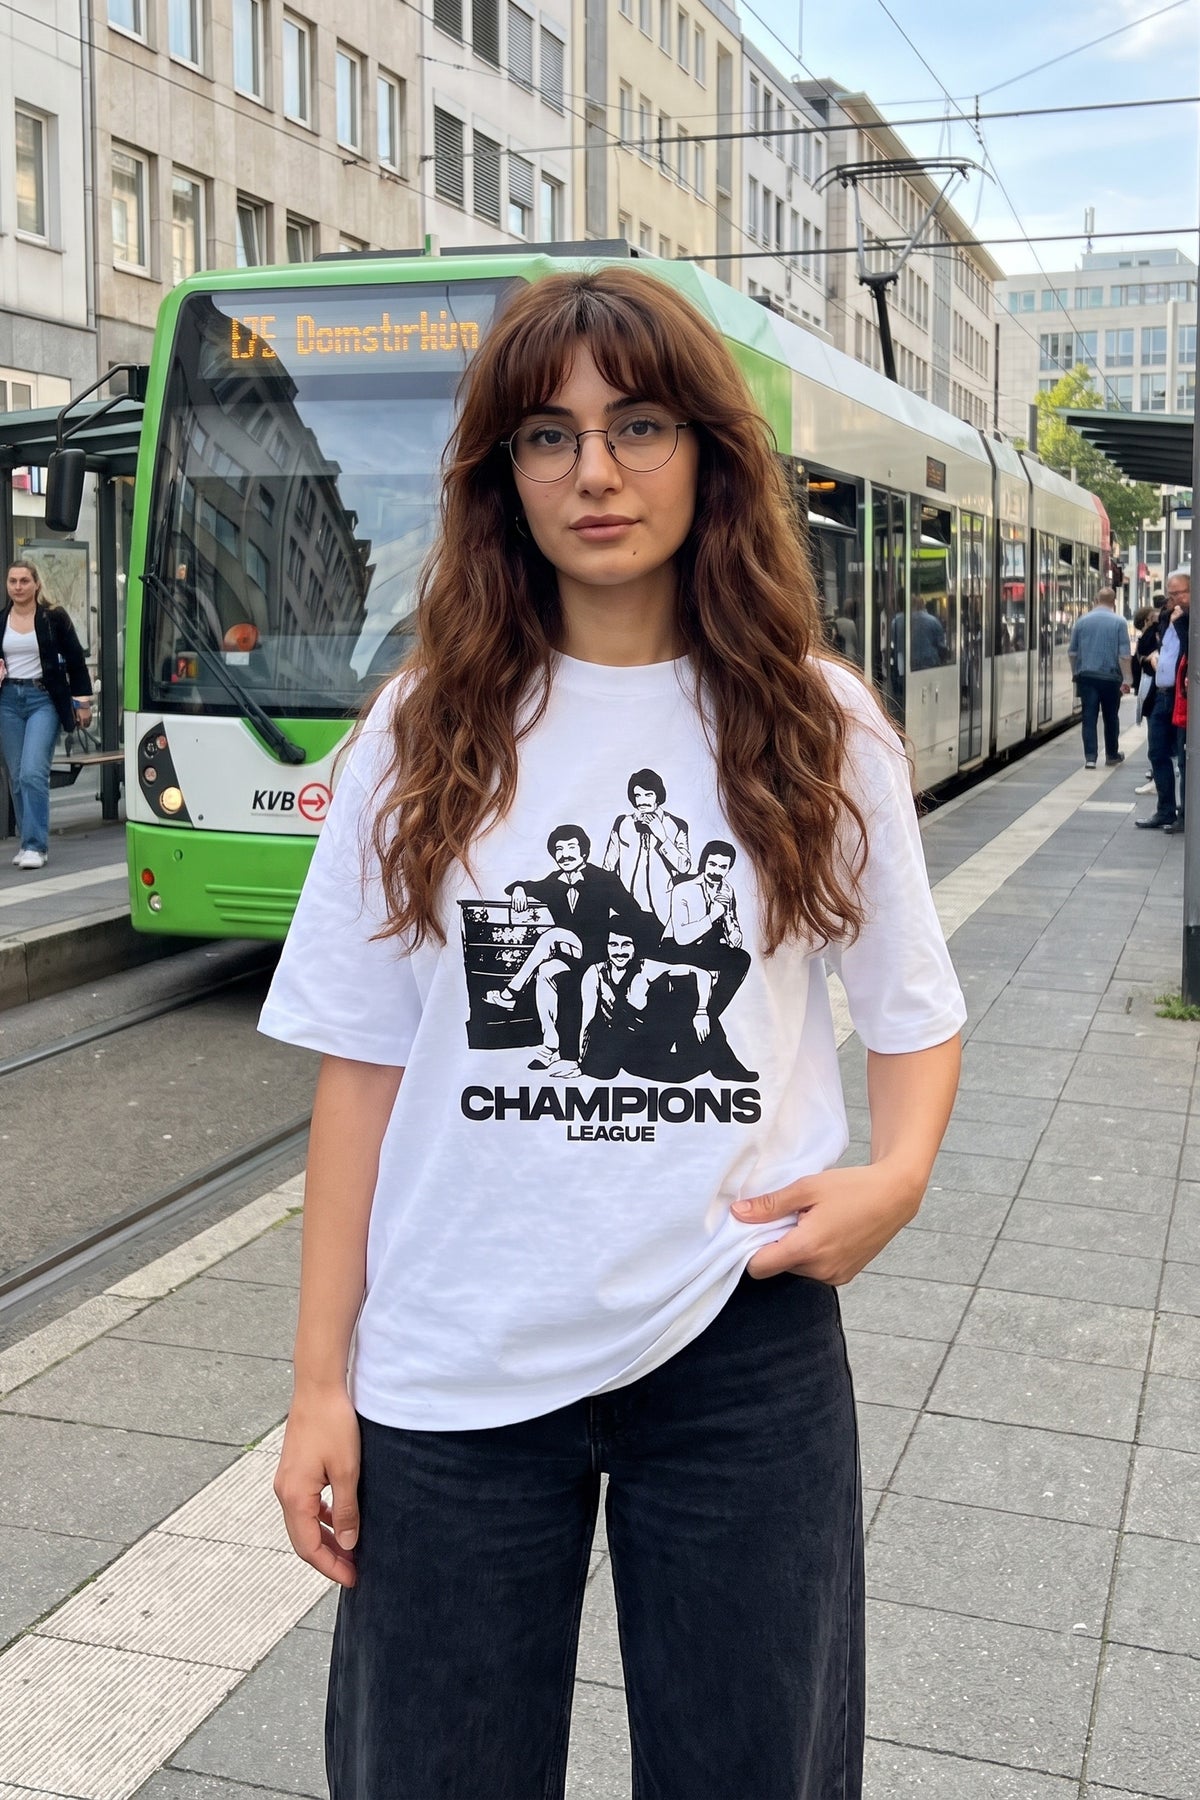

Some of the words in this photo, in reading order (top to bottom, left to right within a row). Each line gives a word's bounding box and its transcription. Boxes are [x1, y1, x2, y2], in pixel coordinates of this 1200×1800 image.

[252, 789, 296, 811] KVB
[460, 1085, 762, 1124] CHAMPIONS
[567, 1125, 655, 1142] LEAGUE
